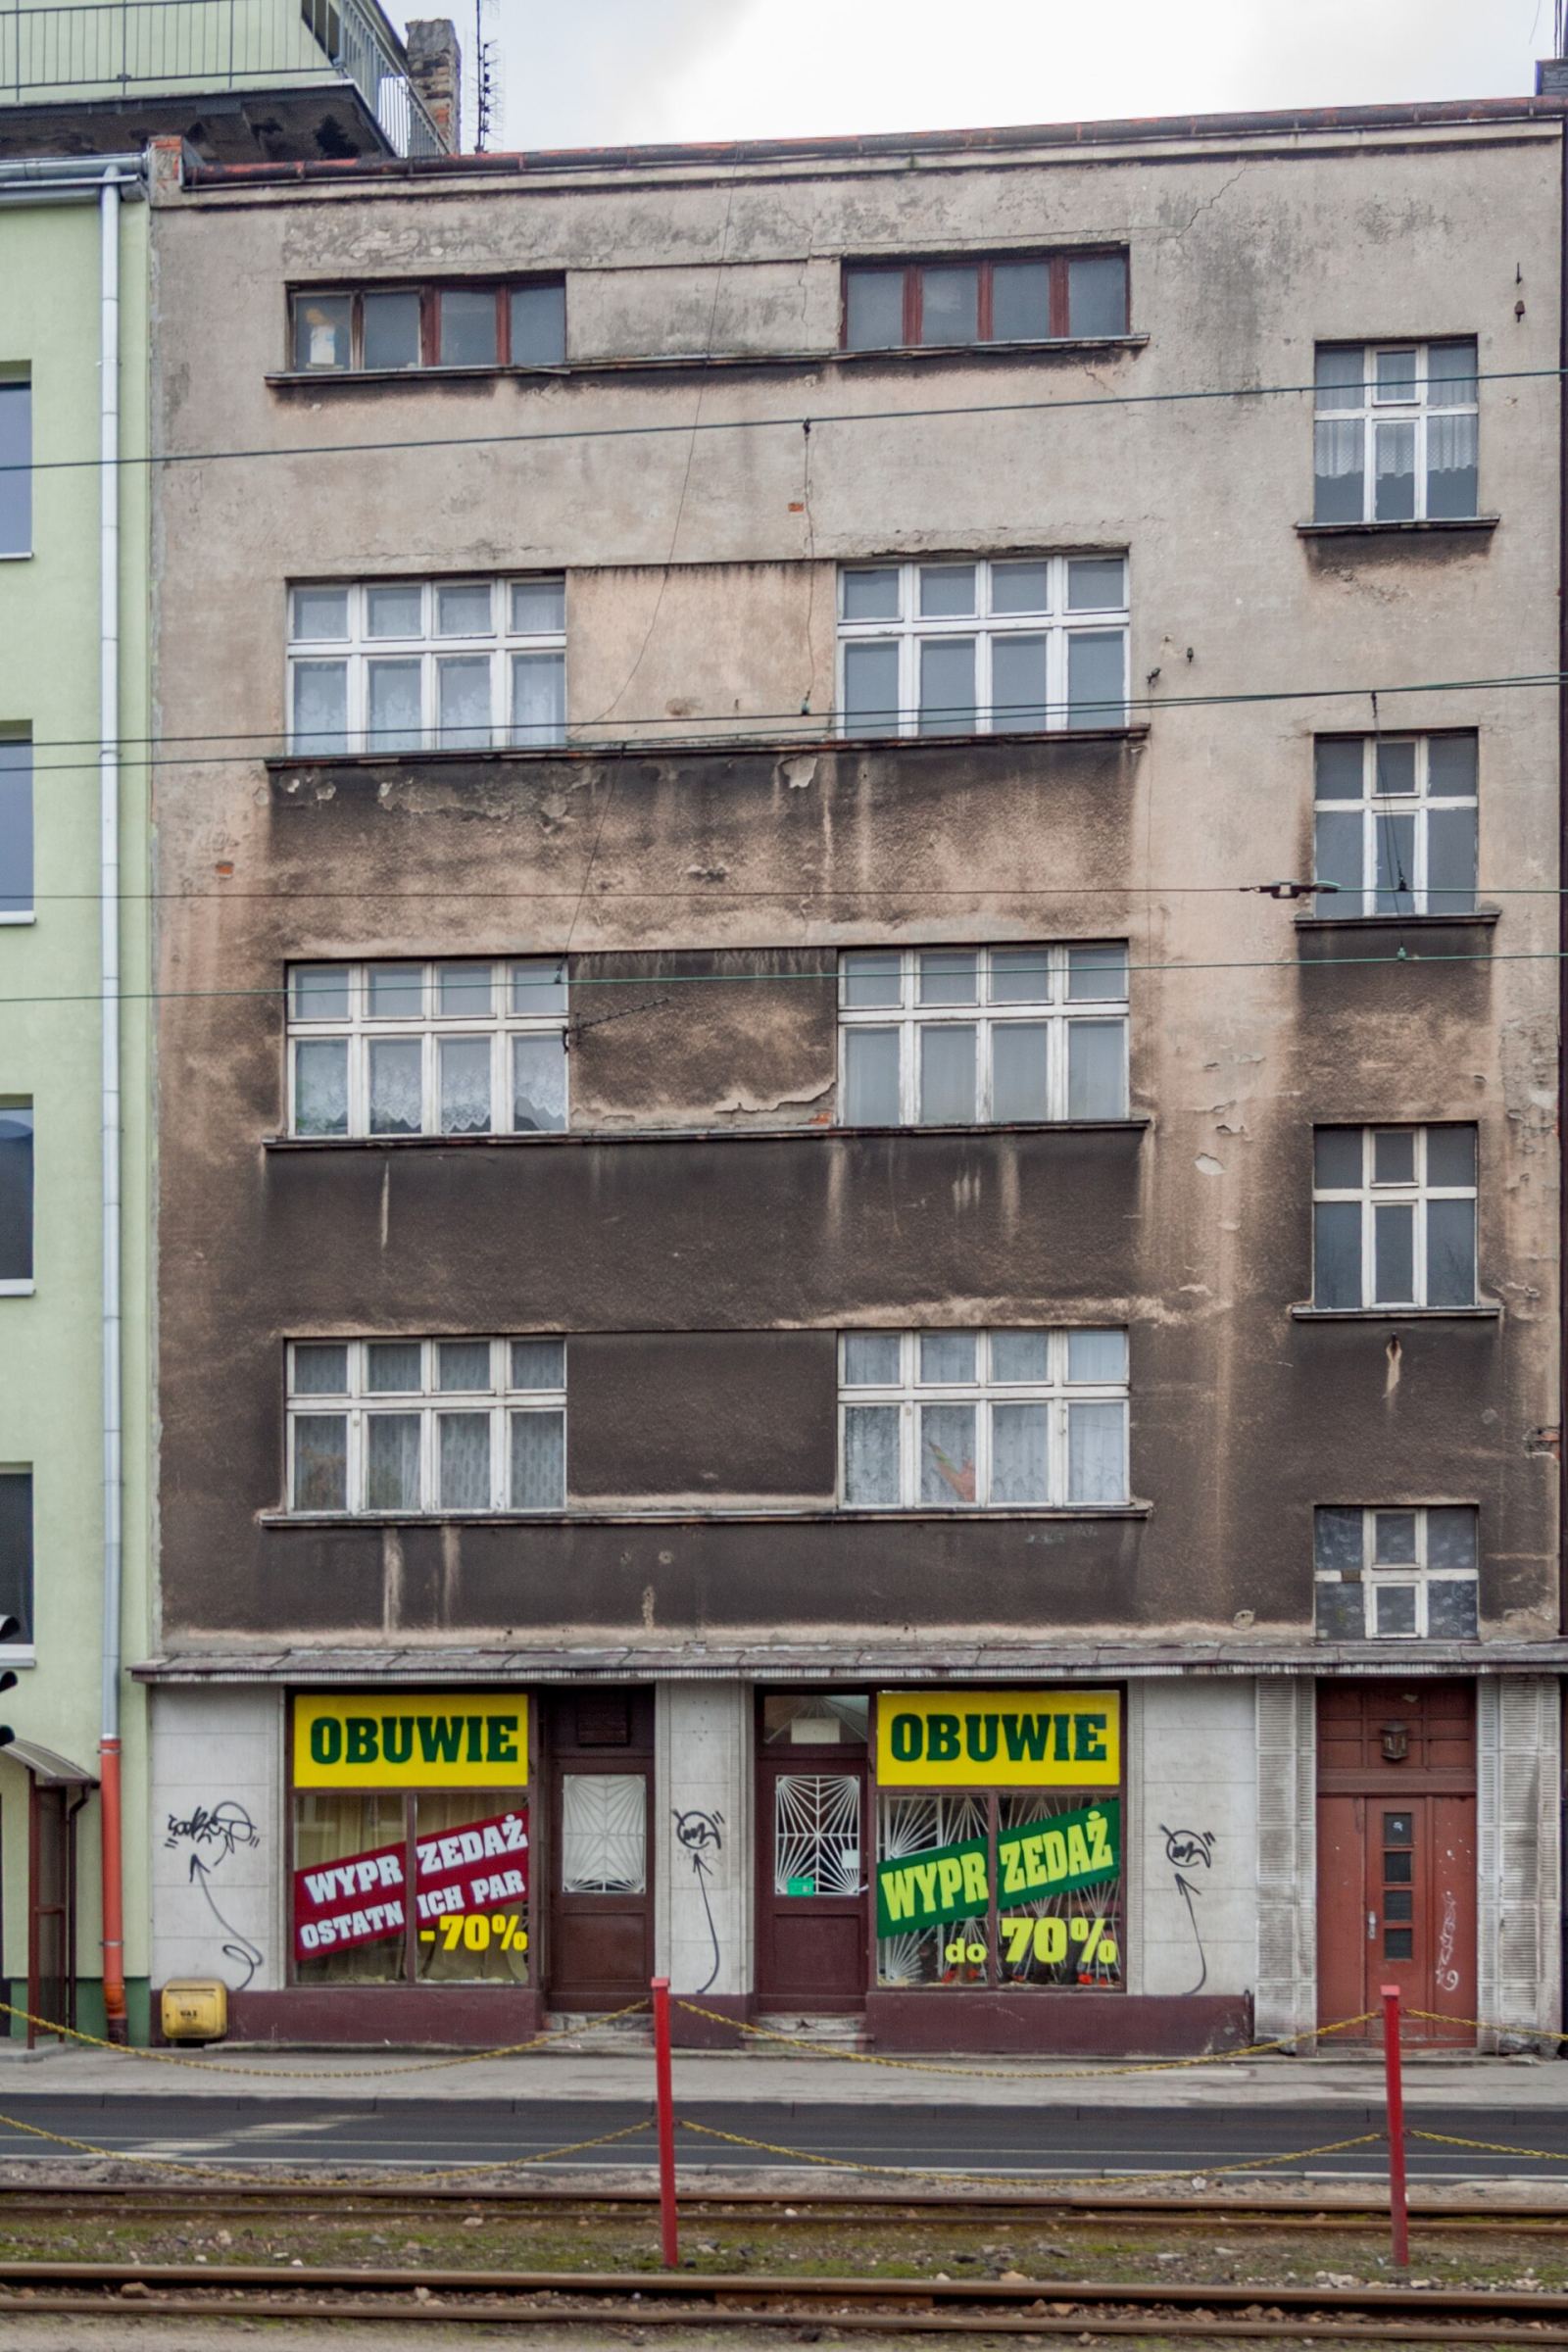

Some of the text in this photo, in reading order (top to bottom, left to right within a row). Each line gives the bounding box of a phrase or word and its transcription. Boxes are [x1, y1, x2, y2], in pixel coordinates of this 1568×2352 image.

[310, 1715, 519, 1764] OBUWIE
[890, 1712, 1107, 1763] OBUWIE
[470, 1869, 525, 1904] PAR
[419, 1914, 528, 1951] -70%
[945, 1916, 1118, 1965] do 70%
